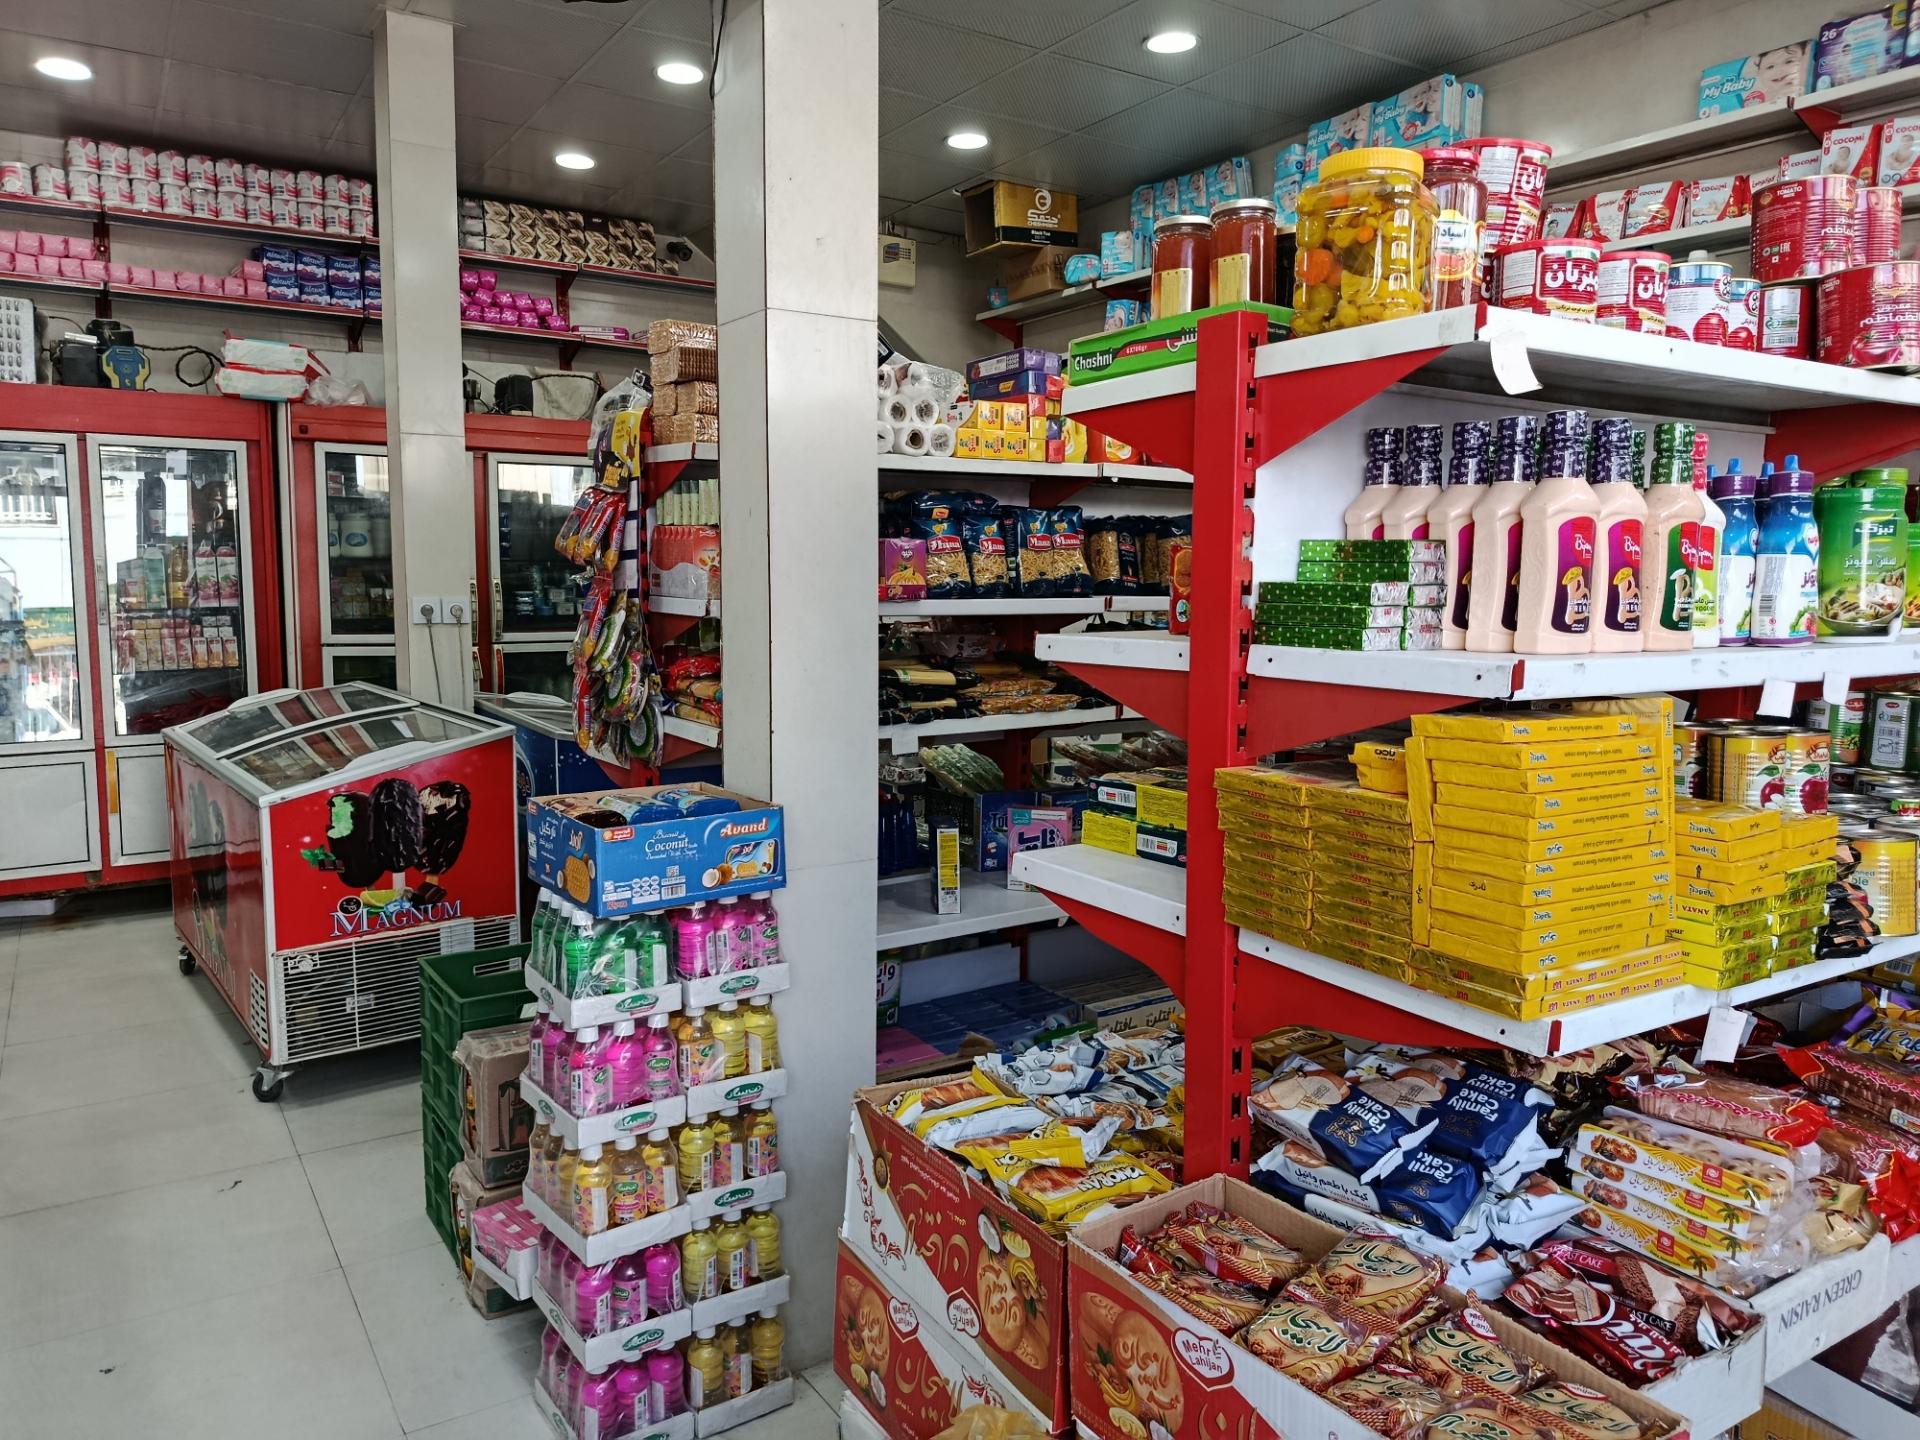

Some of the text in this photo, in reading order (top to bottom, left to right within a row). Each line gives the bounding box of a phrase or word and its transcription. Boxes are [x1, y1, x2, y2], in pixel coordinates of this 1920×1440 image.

[1702, 77, 1756, 100] My Baby
[1777, 186, 1803, 197] TOMATO
[1074, 348, 1113, 371] Chashni
[720, 817, 768, 838] Avand
[1689, 823, 1716, 835] Naderi
[645, 838, 689, 853] Coconut
[1688, 884, 1715, 897] Naderi
[330, 900, 462, 937] MAGNUM
[1682, 905, 1710, 915] ANATA
[1478, 1073, 1516, 1092] Cake
[1357, 1095, 1391, 1120] Cake
[1447, 1096, 1499, 1122] Family
[1459, 1088, 1499, 1110] Cake
[1343, 1101, 1386, 1134] Family
[1408, 1161, 1453, 1184] Famil
[1579, 1254, 1603, 1268] CAKE
[1778, 1269, 1862, 1332] GREEN RAISIN
[1649, 1315, 1673, 1331] CAKE
[1182, 1338, 1214, 1358] Mehr
[1189, 1356, 1223, 1374] Lahijan
